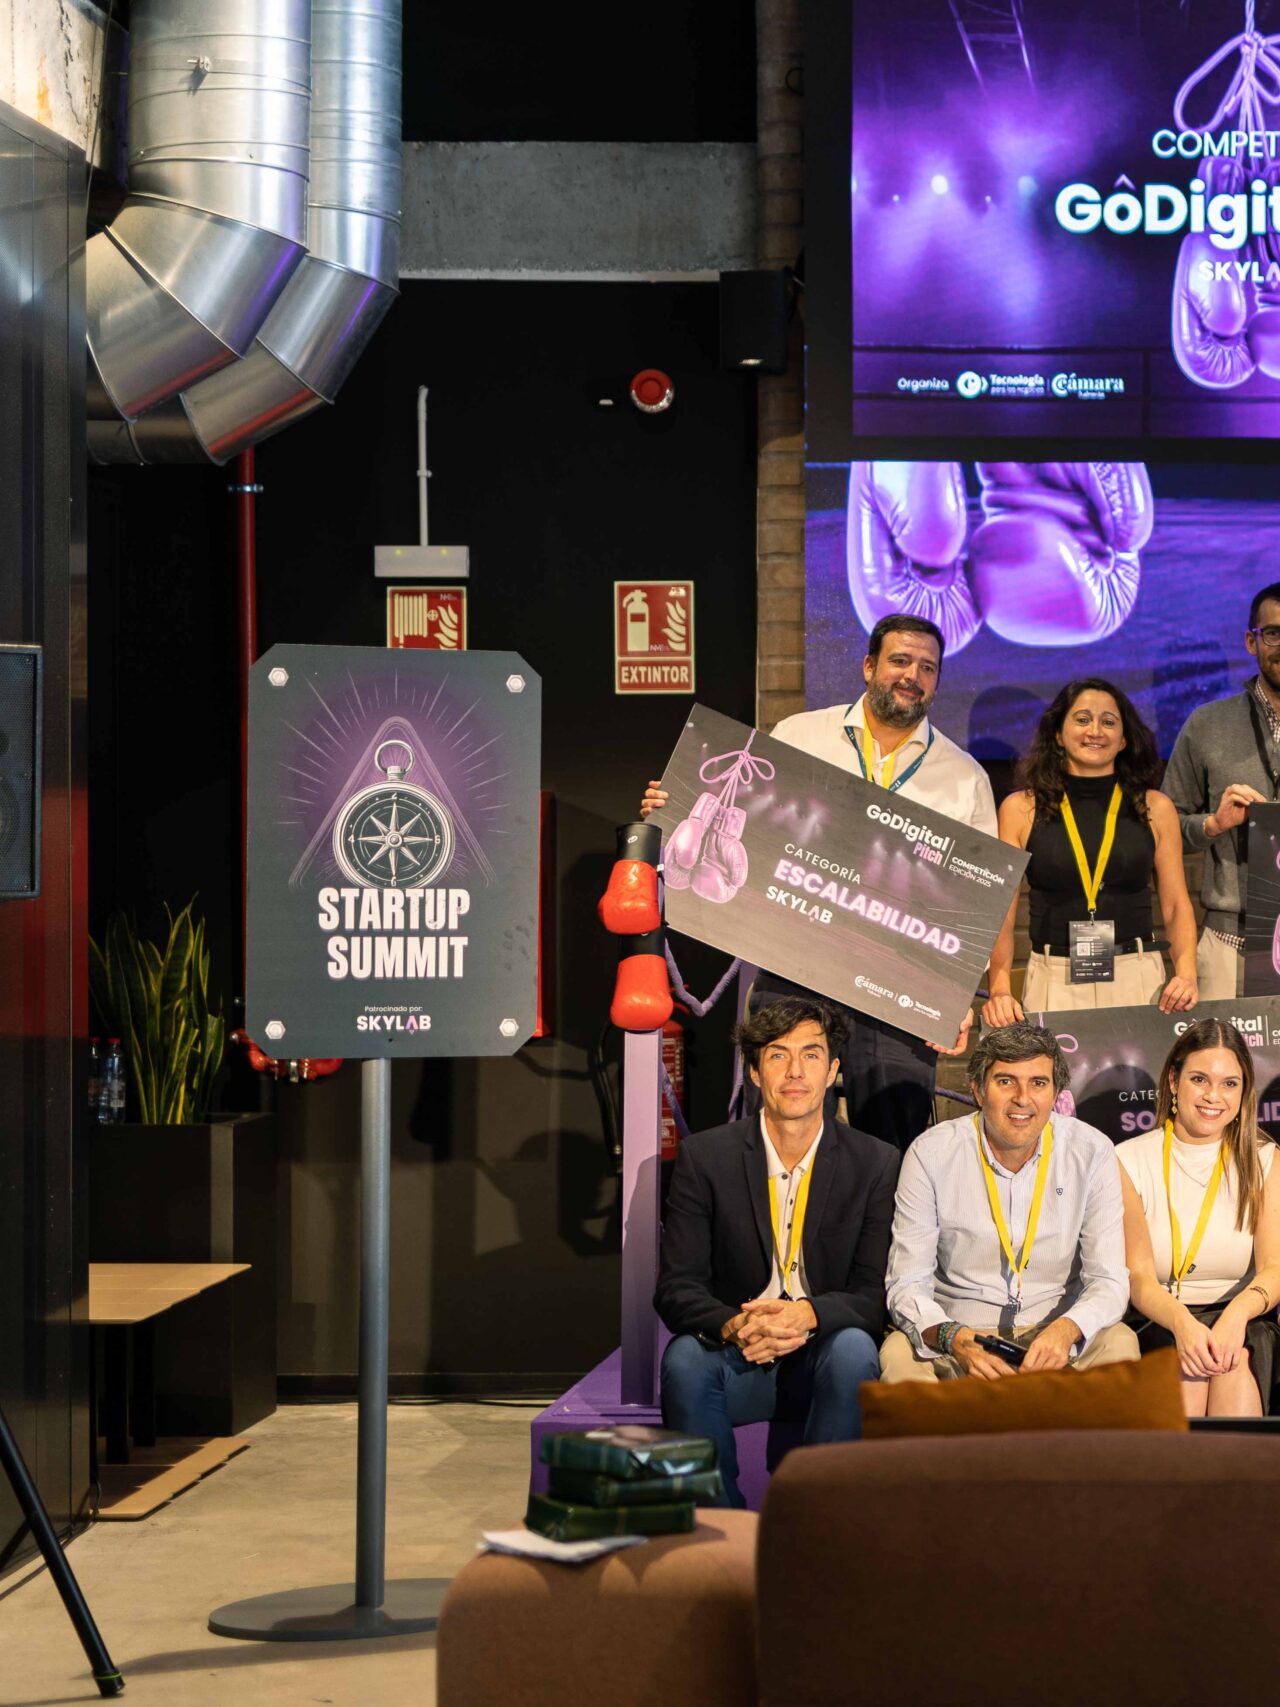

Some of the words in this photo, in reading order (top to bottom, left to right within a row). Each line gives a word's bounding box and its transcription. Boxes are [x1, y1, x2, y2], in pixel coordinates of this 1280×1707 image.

[898, 377, 949, 393] Organiza
[990, 374, 1044, 387] Tecnología
[1051, 372, 1125, 397] Cámara
[621, 666, 689, 684] EXTINTOR
[784, 843, 862, 885] CATEGORÍA
[913, 842, 943, 866] Pitch
[948, 864, 976, 881] EDICIÓN
[976, 876, 991, 888] 2025
[952, 856, 1005, 885] COMPETICIÓN
[318, 888, 470, 930] STARTUP
[766, 885, 833, 925] SKYLAB
[773, 858, 962, 956] ESCALABILIDAD
[327, 936, 468, 979] SUMMIT
[855, 975, 894, 999] Cámara
[356, 1015, 431, 1034] SKYLAB
